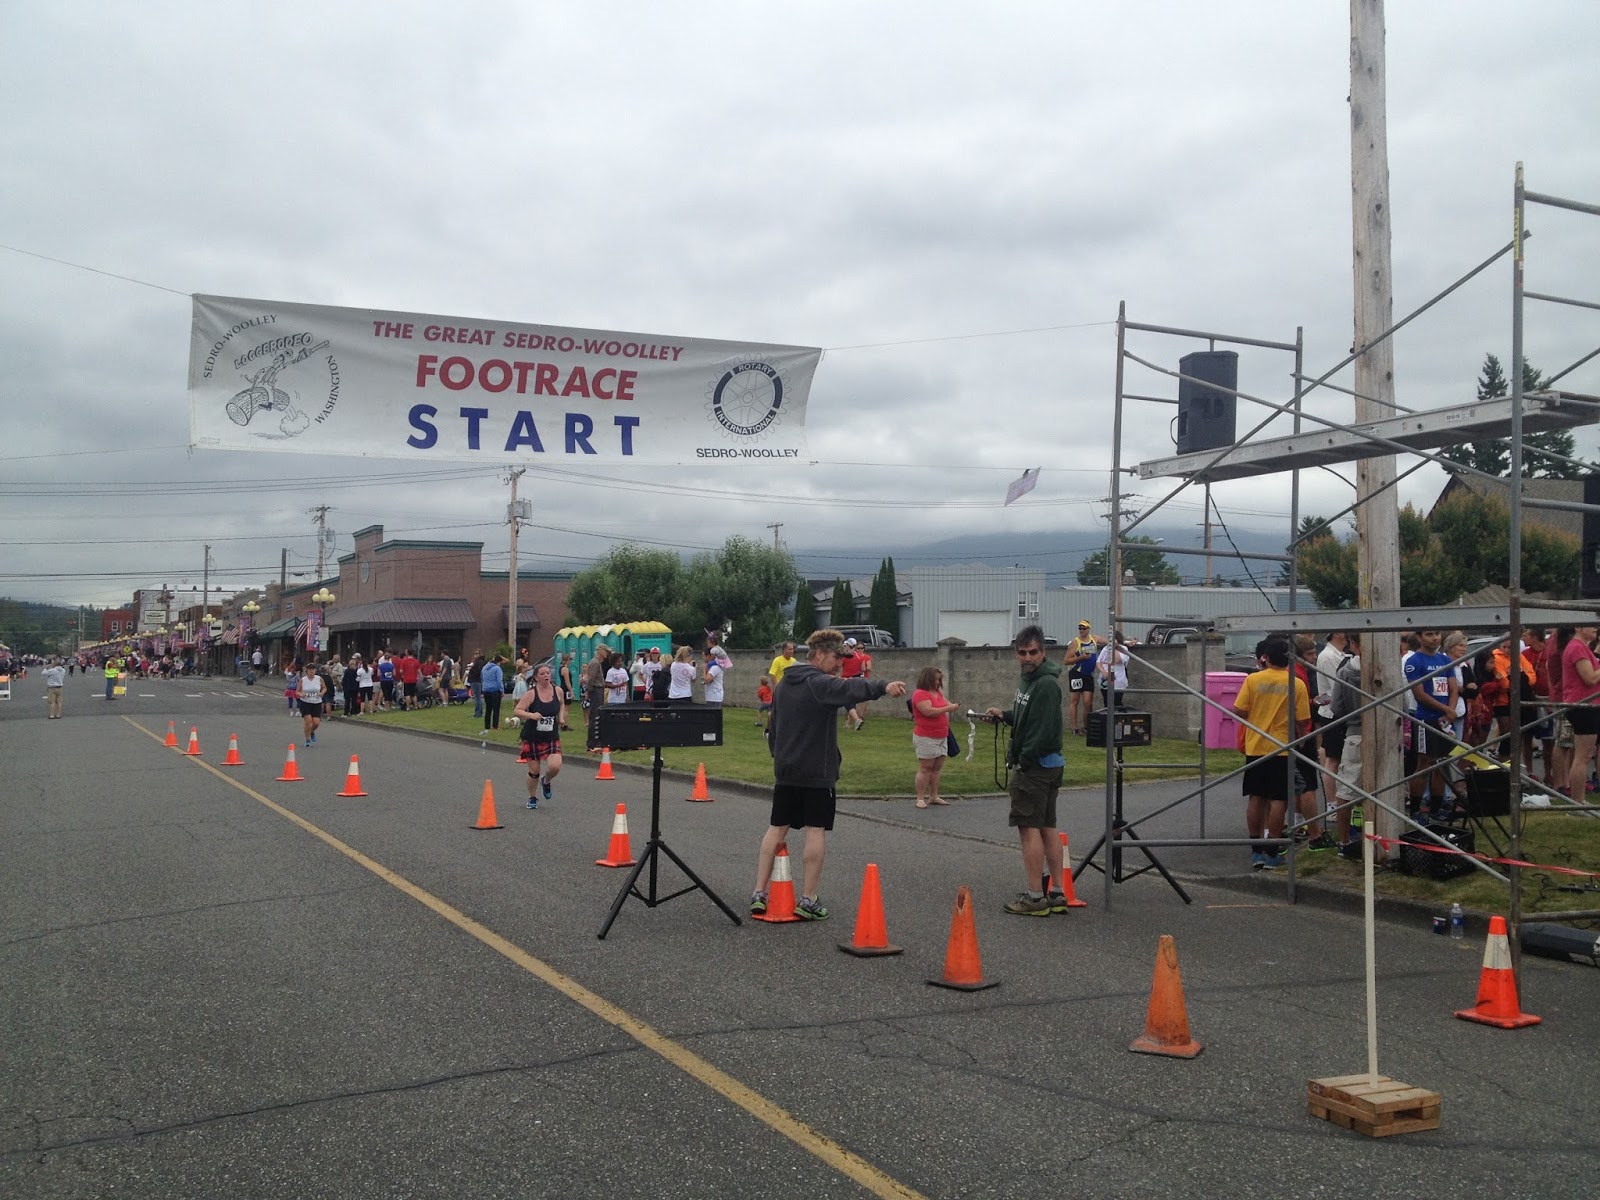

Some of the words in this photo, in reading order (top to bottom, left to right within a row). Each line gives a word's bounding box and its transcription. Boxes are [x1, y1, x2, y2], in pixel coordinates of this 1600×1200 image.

[203, 314, 277, 378] SEDRO-WOOLLEY
[373, 320, 414, 339] THE
[423, 324, 495, 346] GREAT
[503, 331, 684, 361] SEDRO-WOOLLEY
[314, 354, 340, 425] WASHINGTON
[416, 354, 638, 401] FOOTRACE
[738, 363, 773, 375] ROTARY
[406, 403, 640, 456] START
[716, 410, 775, 435] INTERNATIONAL
[696, 448, 799, 458] SEDRO-WOOLLEY
